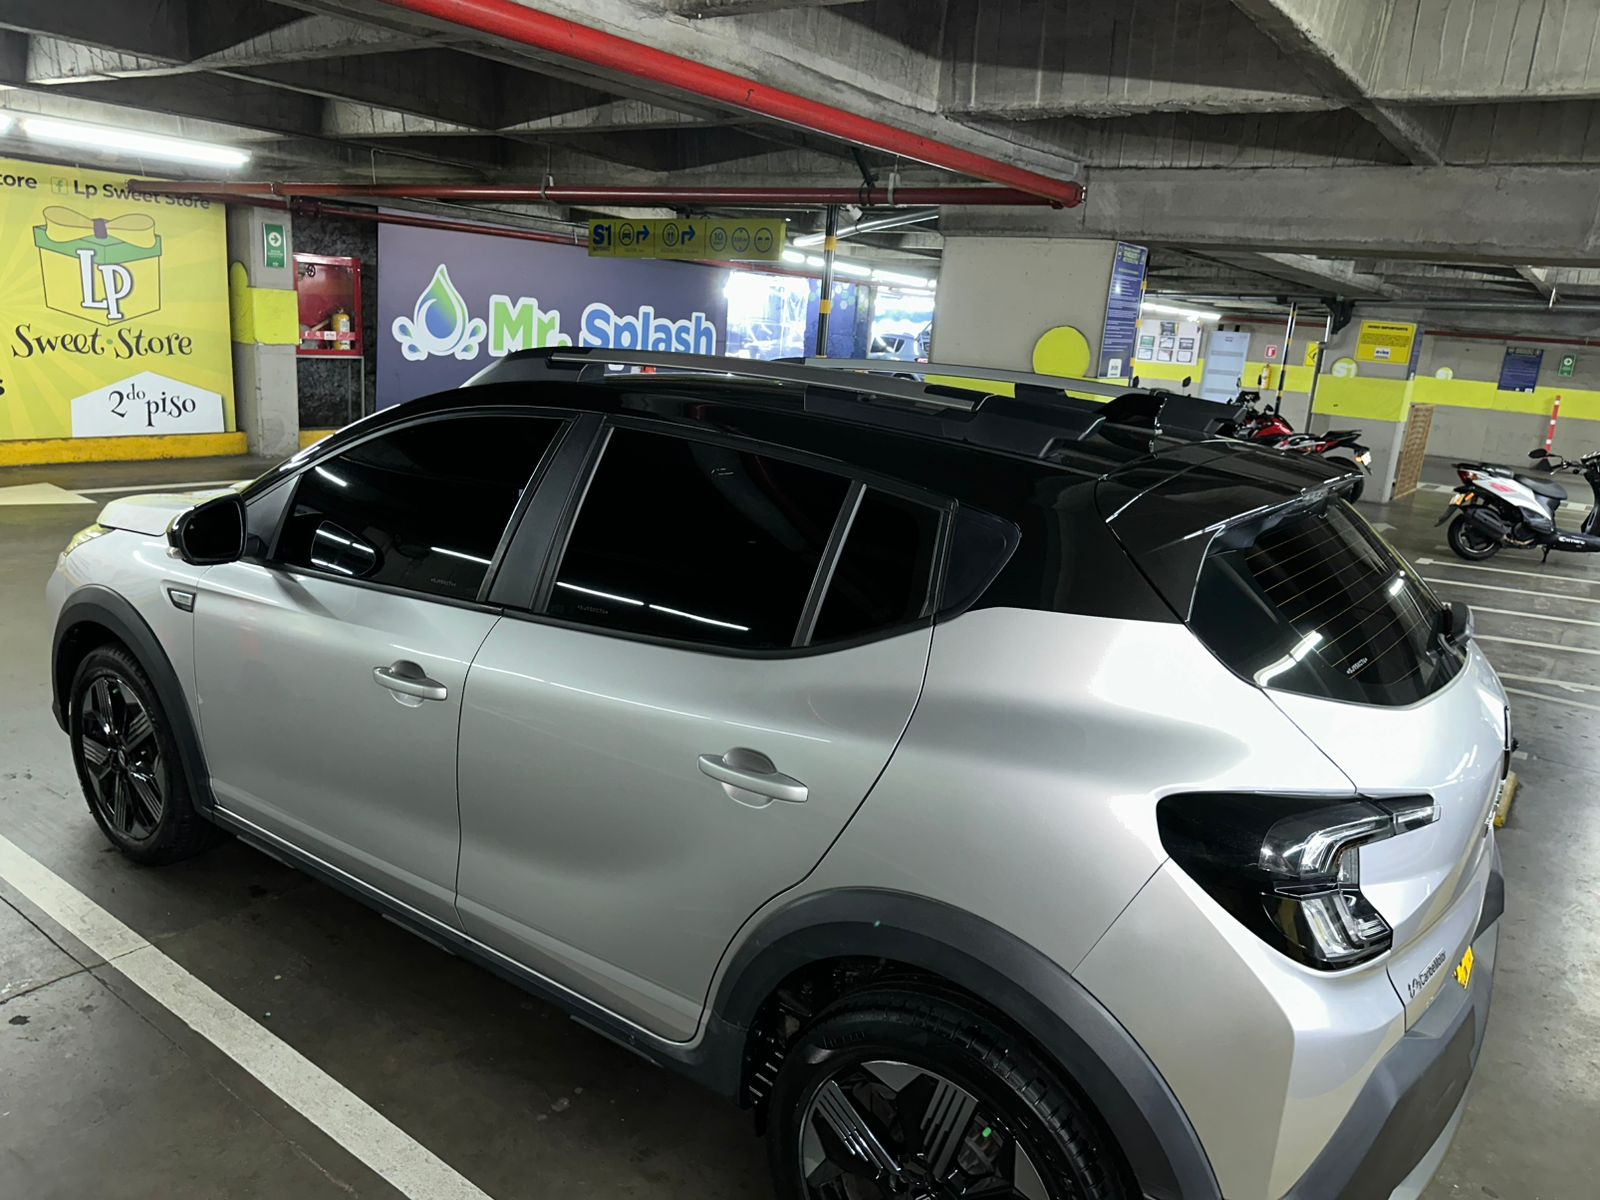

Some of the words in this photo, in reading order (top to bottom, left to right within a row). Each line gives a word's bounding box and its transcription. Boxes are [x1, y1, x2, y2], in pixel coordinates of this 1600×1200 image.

[74, 180, 98, 198] Lp
[103, 183, 161, 204] Sweet
[165, 191, 211, 210] Store
[592, 224, 613, 246] S1
[76, 249, 133, 320] LP
[11, 324, 105, 358] Sweet
[115, 328, 193, 359] Store
[580, 304, 717, 356] Splash
[109, 383, 146, 418] 2do
[146, 391, 196, 427] piso
